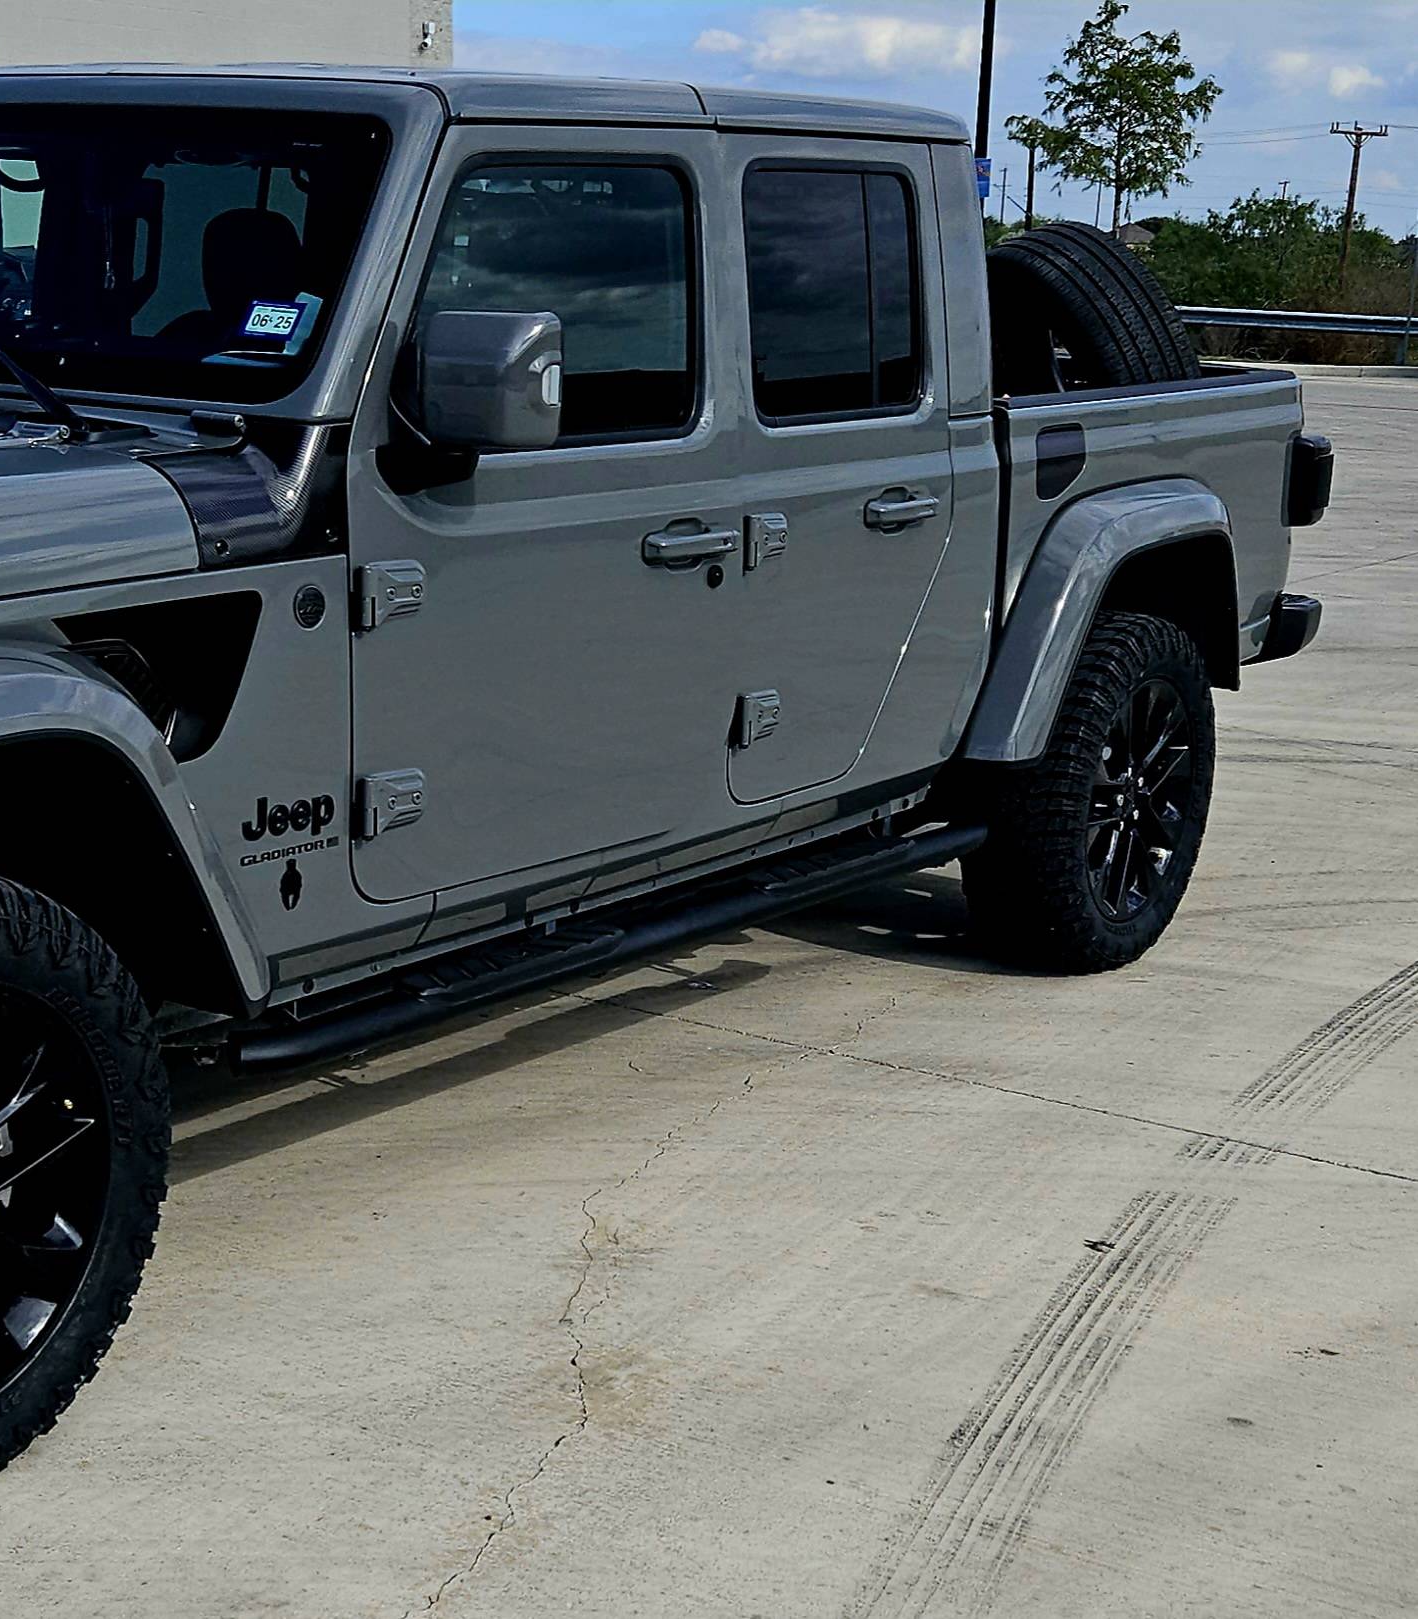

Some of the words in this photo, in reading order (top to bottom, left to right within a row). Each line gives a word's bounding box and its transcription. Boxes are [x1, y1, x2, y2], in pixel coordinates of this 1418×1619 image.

[251, 314, 270, 327] 06
[273, 316, 294, 329] 25
[242, 794, 335, 842] Jeep
[240, 839, 325, 867] GLADIATOR
